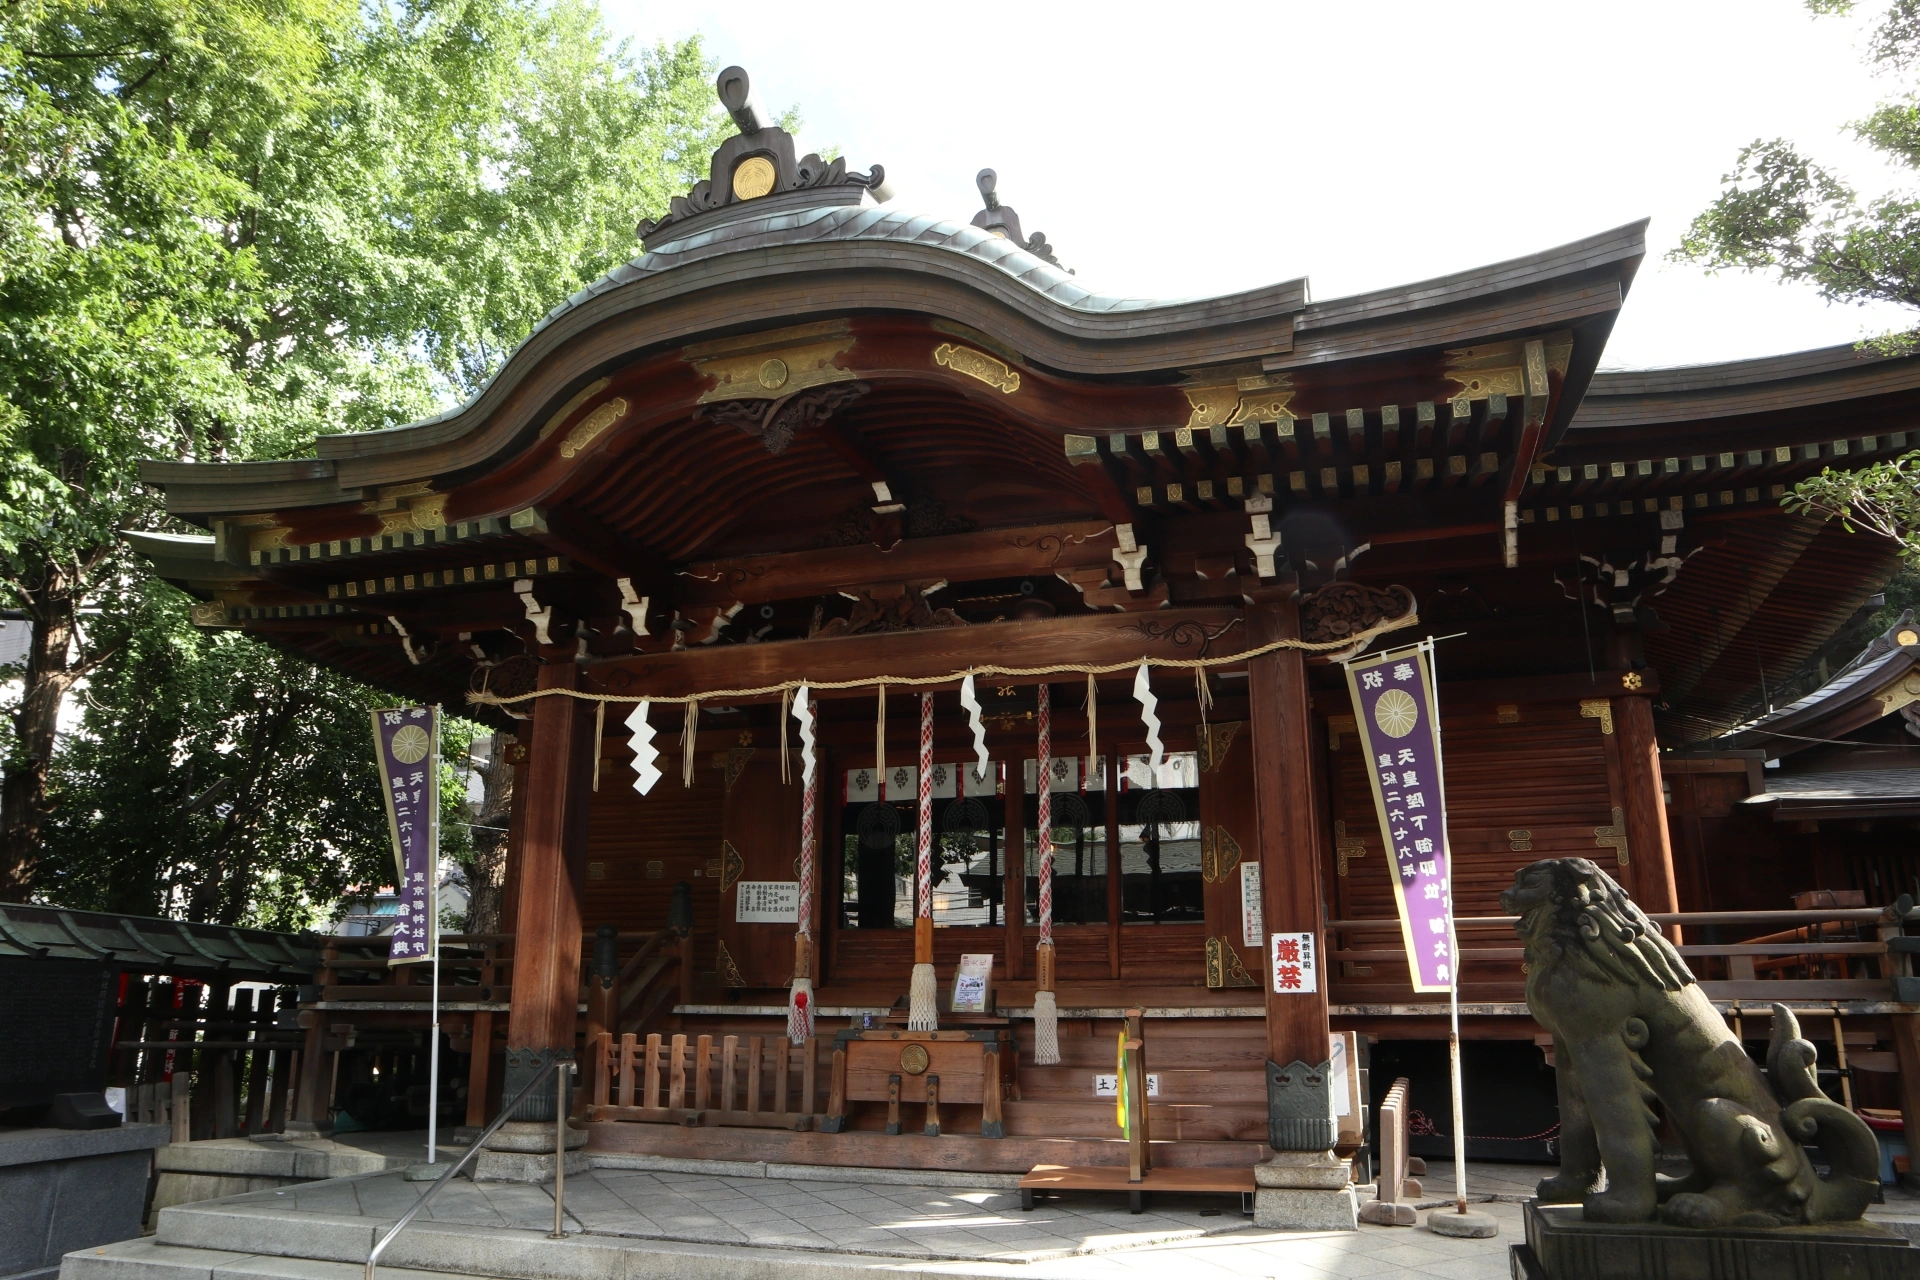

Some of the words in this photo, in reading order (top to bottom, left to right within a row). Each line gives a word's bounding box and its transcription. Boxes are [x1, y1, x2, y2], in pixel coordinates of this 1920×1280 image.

[1276, 938, 1302, 990] 厳禁
[1302, 934, 1312, 970] 無断昇殿
